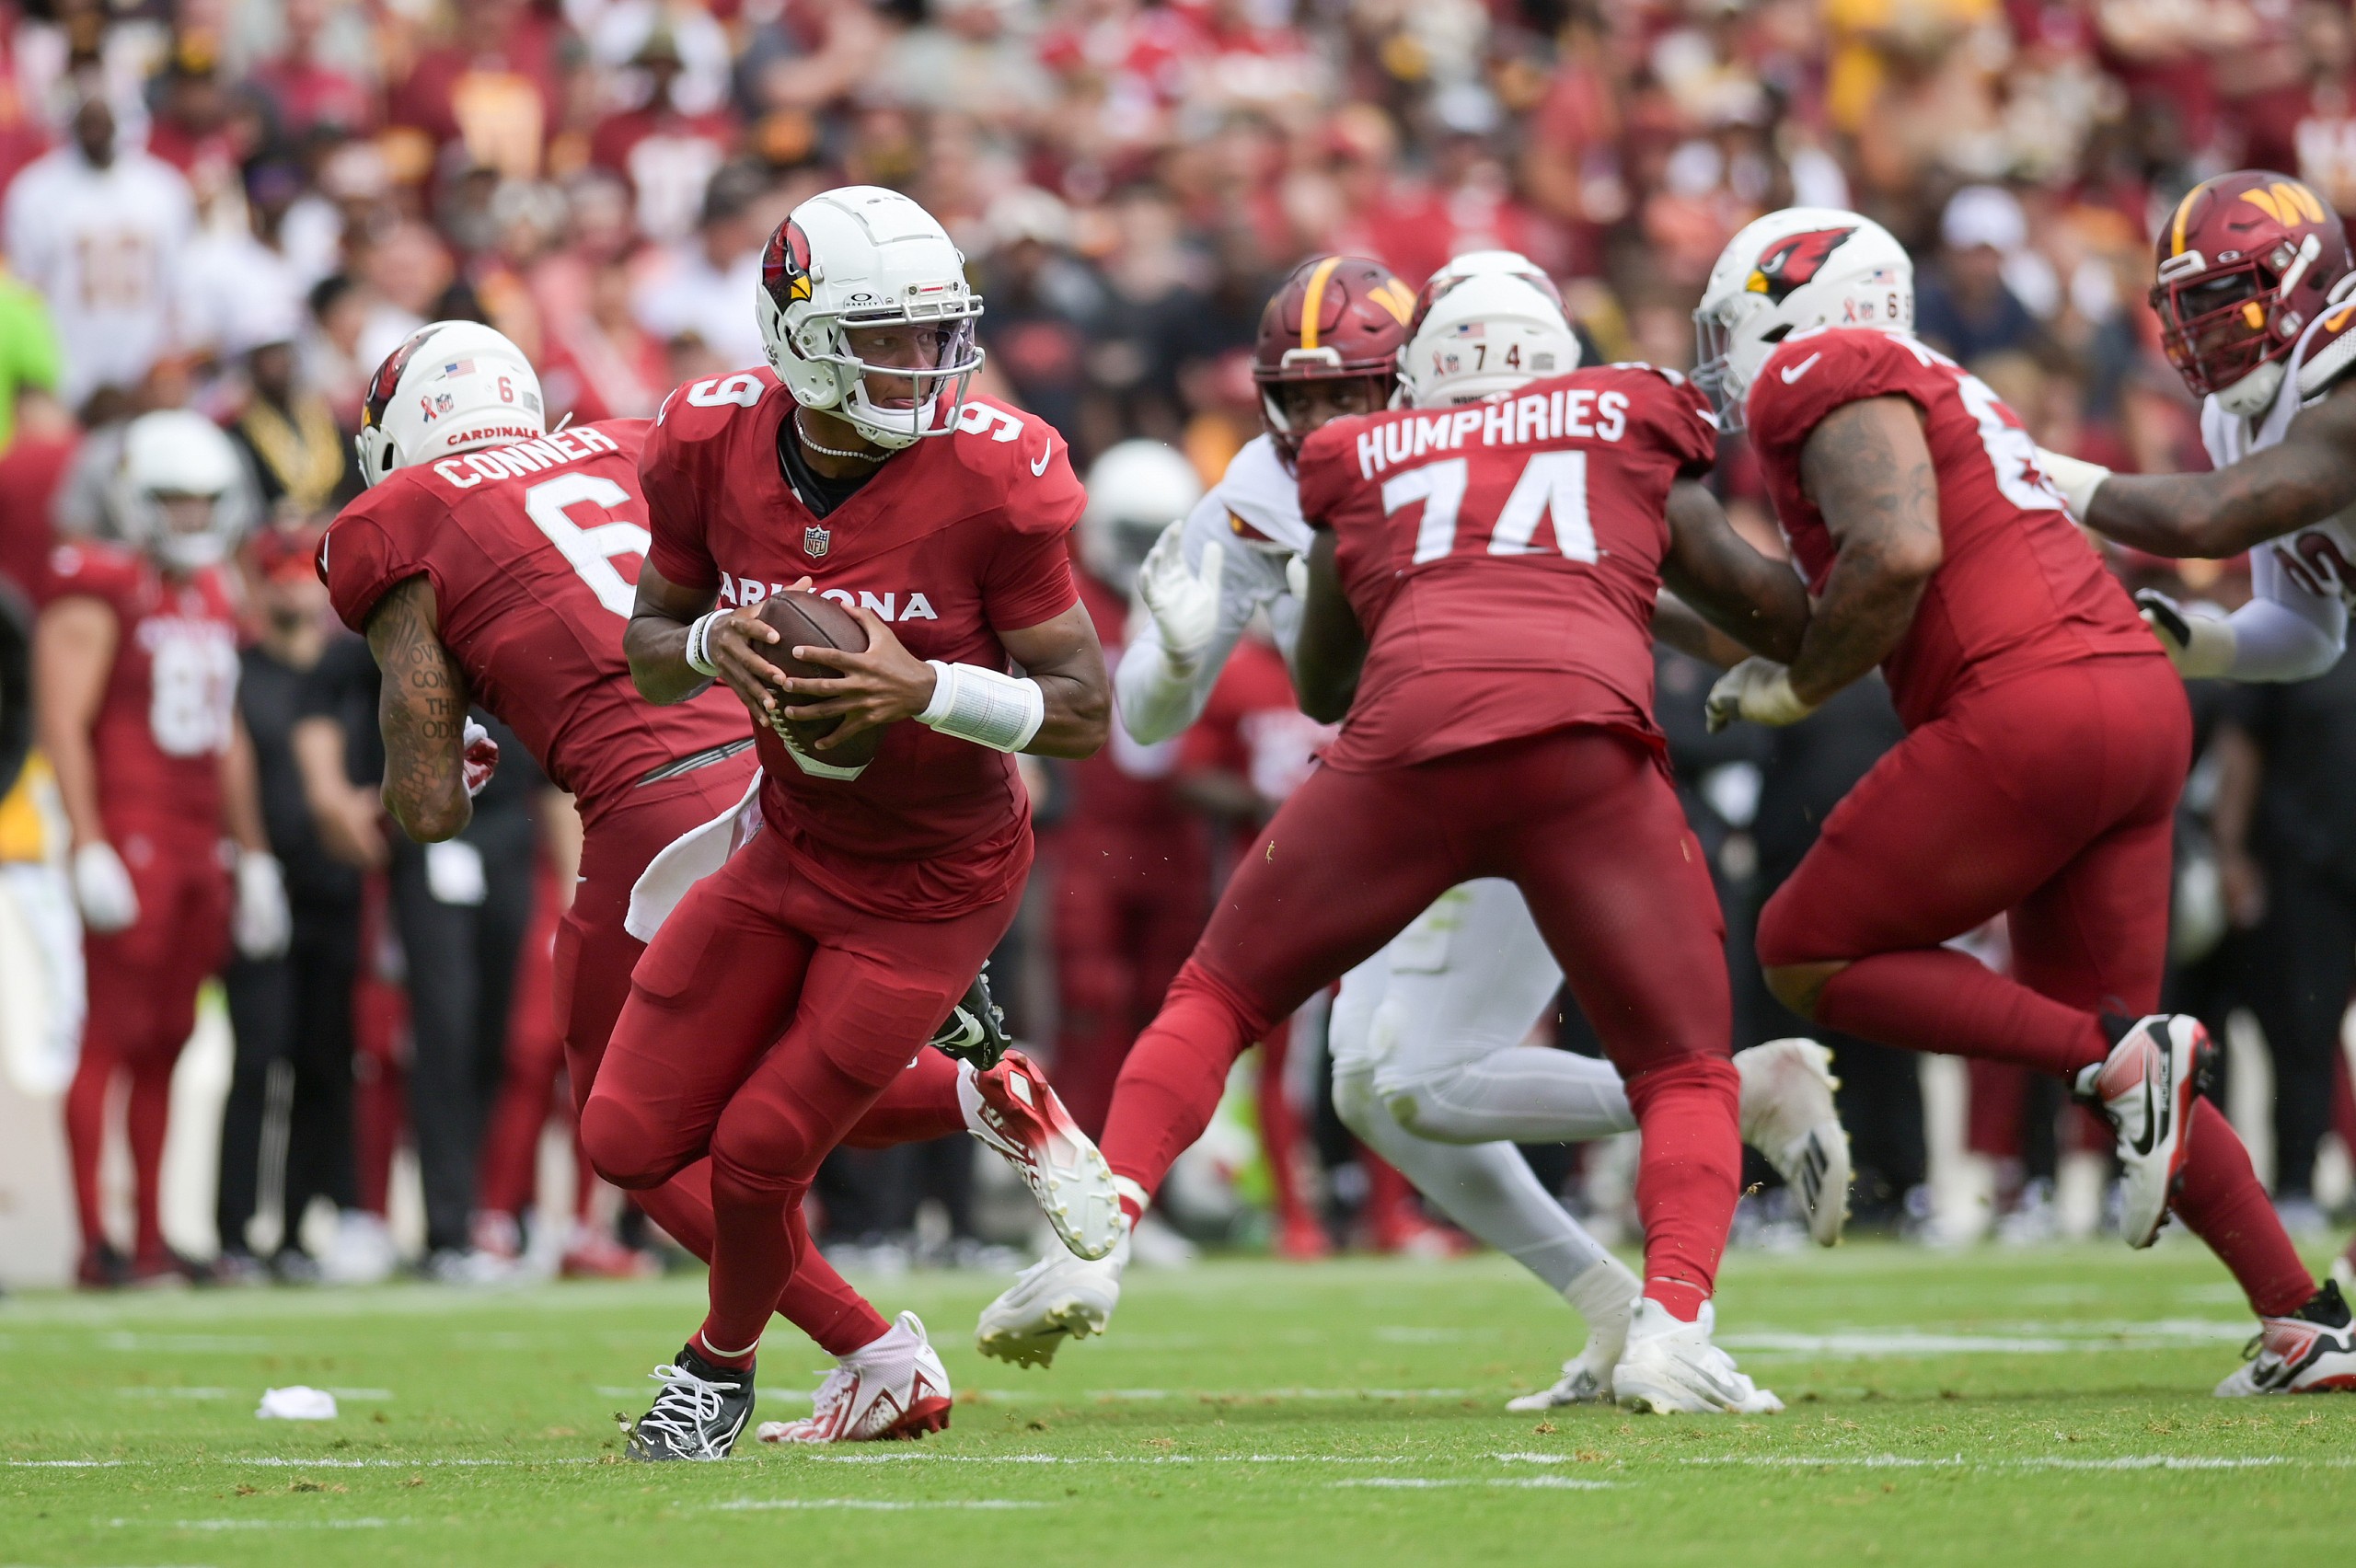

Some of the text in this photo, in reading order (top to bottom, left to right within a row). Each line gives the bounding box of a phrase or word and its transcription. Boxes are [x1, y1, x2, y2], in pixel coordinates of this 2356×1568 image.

[845, 300, 879, 308] OAKLEY
[497, 375, 514, 403] 6
[687, 374, 765, 408] 9
[447, 426, 538, 445] CARDINALS
[944, 401, 1024, 443] 9
[1357, 390, 1630, 480] HUMPHRIES
[433, 426, 619, 489] CONNER
[1381, 449, 1608, 566] 74
[525, 472, 652, 620] 6
[807, 538, 825, 553] NFL
